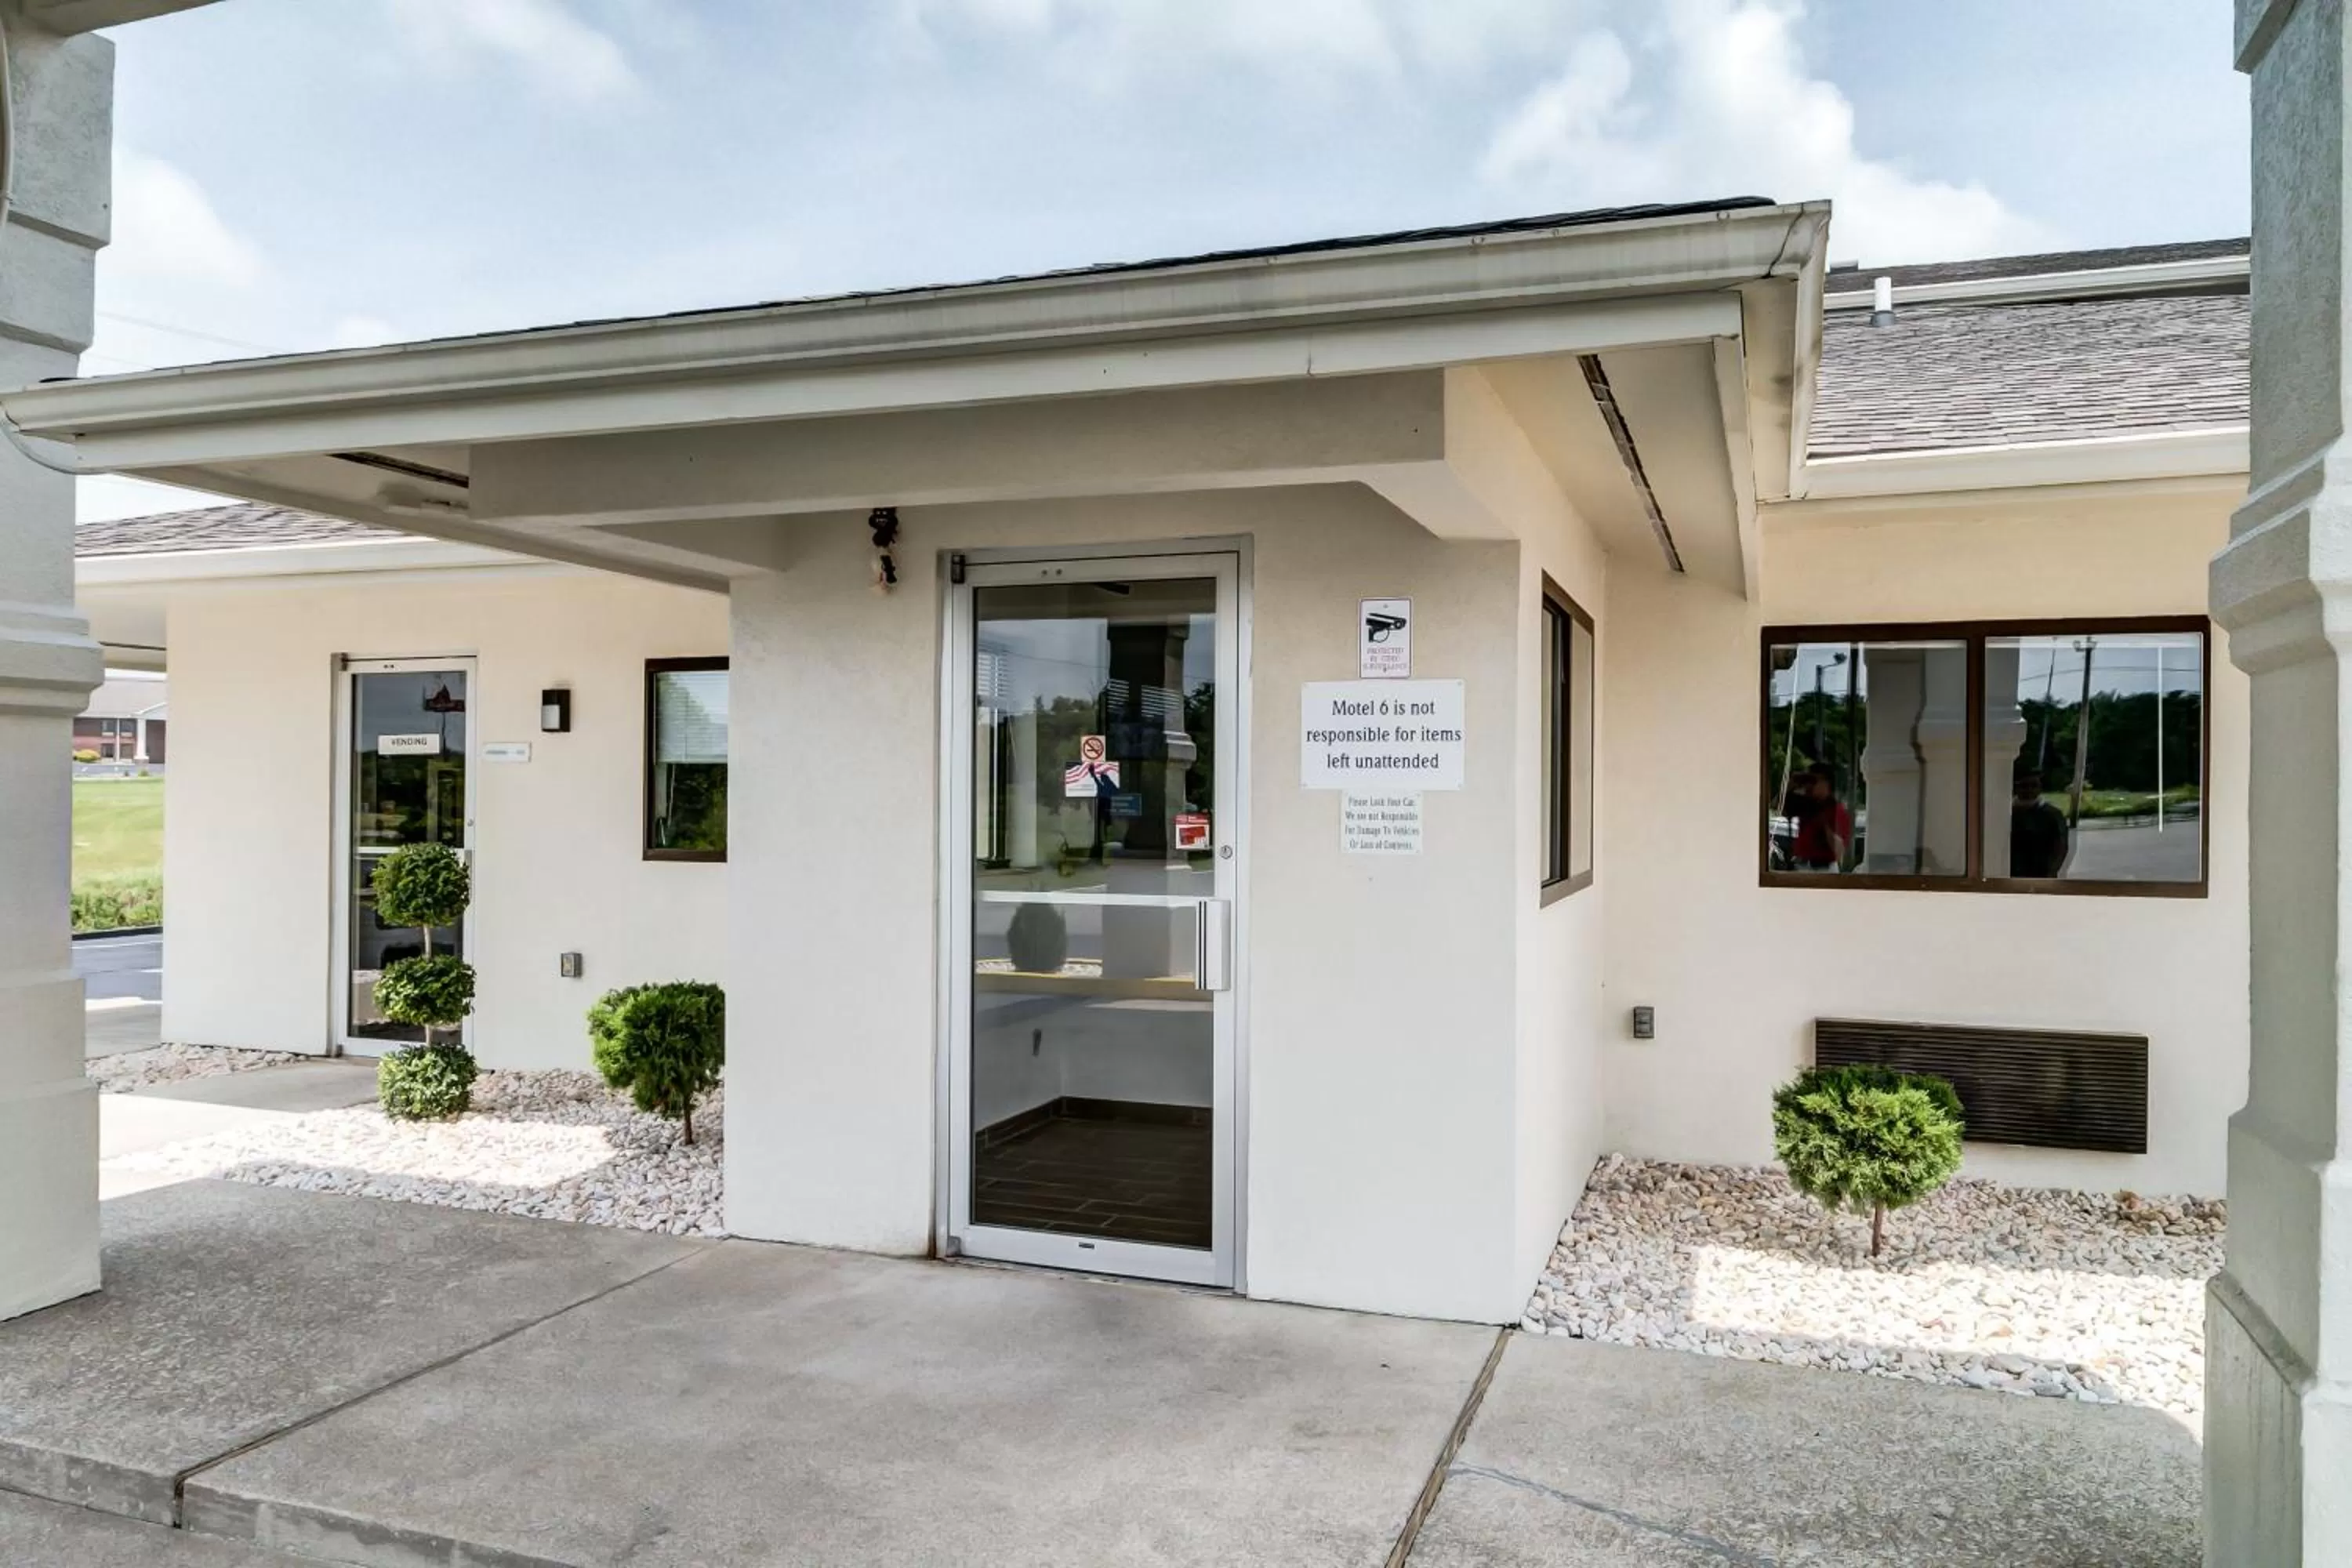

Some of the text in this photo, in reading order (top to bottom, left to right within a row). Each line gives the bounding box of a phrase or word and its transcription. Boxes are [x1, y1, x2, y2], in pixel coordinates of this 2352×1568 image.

[1332, 699, 1435, 716] Motel 6 is not
[391, 737, 427, 746] VENDING
[1306, 726, 1461, 746] responsible for items
[1327, 753, 1439, 769] left unattended
